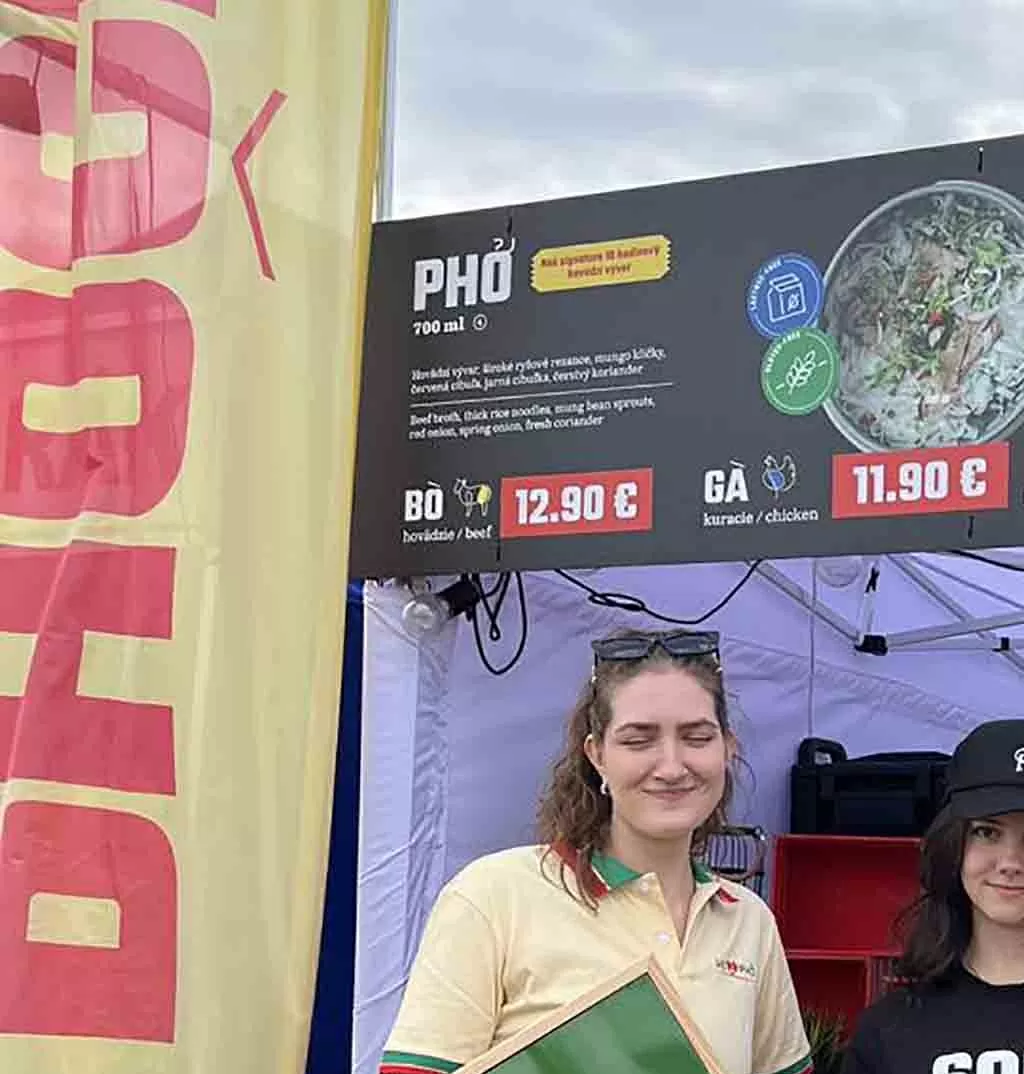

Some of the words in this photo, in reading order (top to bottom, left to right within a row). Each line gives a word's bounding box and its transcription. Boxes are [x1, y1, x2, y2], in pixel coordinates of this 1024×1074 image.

[413, 237, 516, 311] PHỞ
[413, 320, 440, 335] 700
[443, 315, 465, 333] ml
[594, 351, 632, 365] mungo
[592, 364, 643, 378] koriander
[554, 403, 585, 415] mung
[586, 400, 612, 411] bean
[408, 427, 426, 440] red
[459, 424, 492, 439] spring
[525, 418, 553, 430] fresh
[553, 415, 605, 429] coriander
[703, 459, 750, 505] GÀ
[852, 460, 949, 505] 11.90
[960, 457, 987, 497] €
[403, 481, 444, 521] BÒ
[515, 484, 605, 525] 12.90
[613, 481, 638, 520] €
[703, 509, 754, 527] kuracie
[765, 506, 819, 524] chicken
[465, 524, 493, 539] beef
